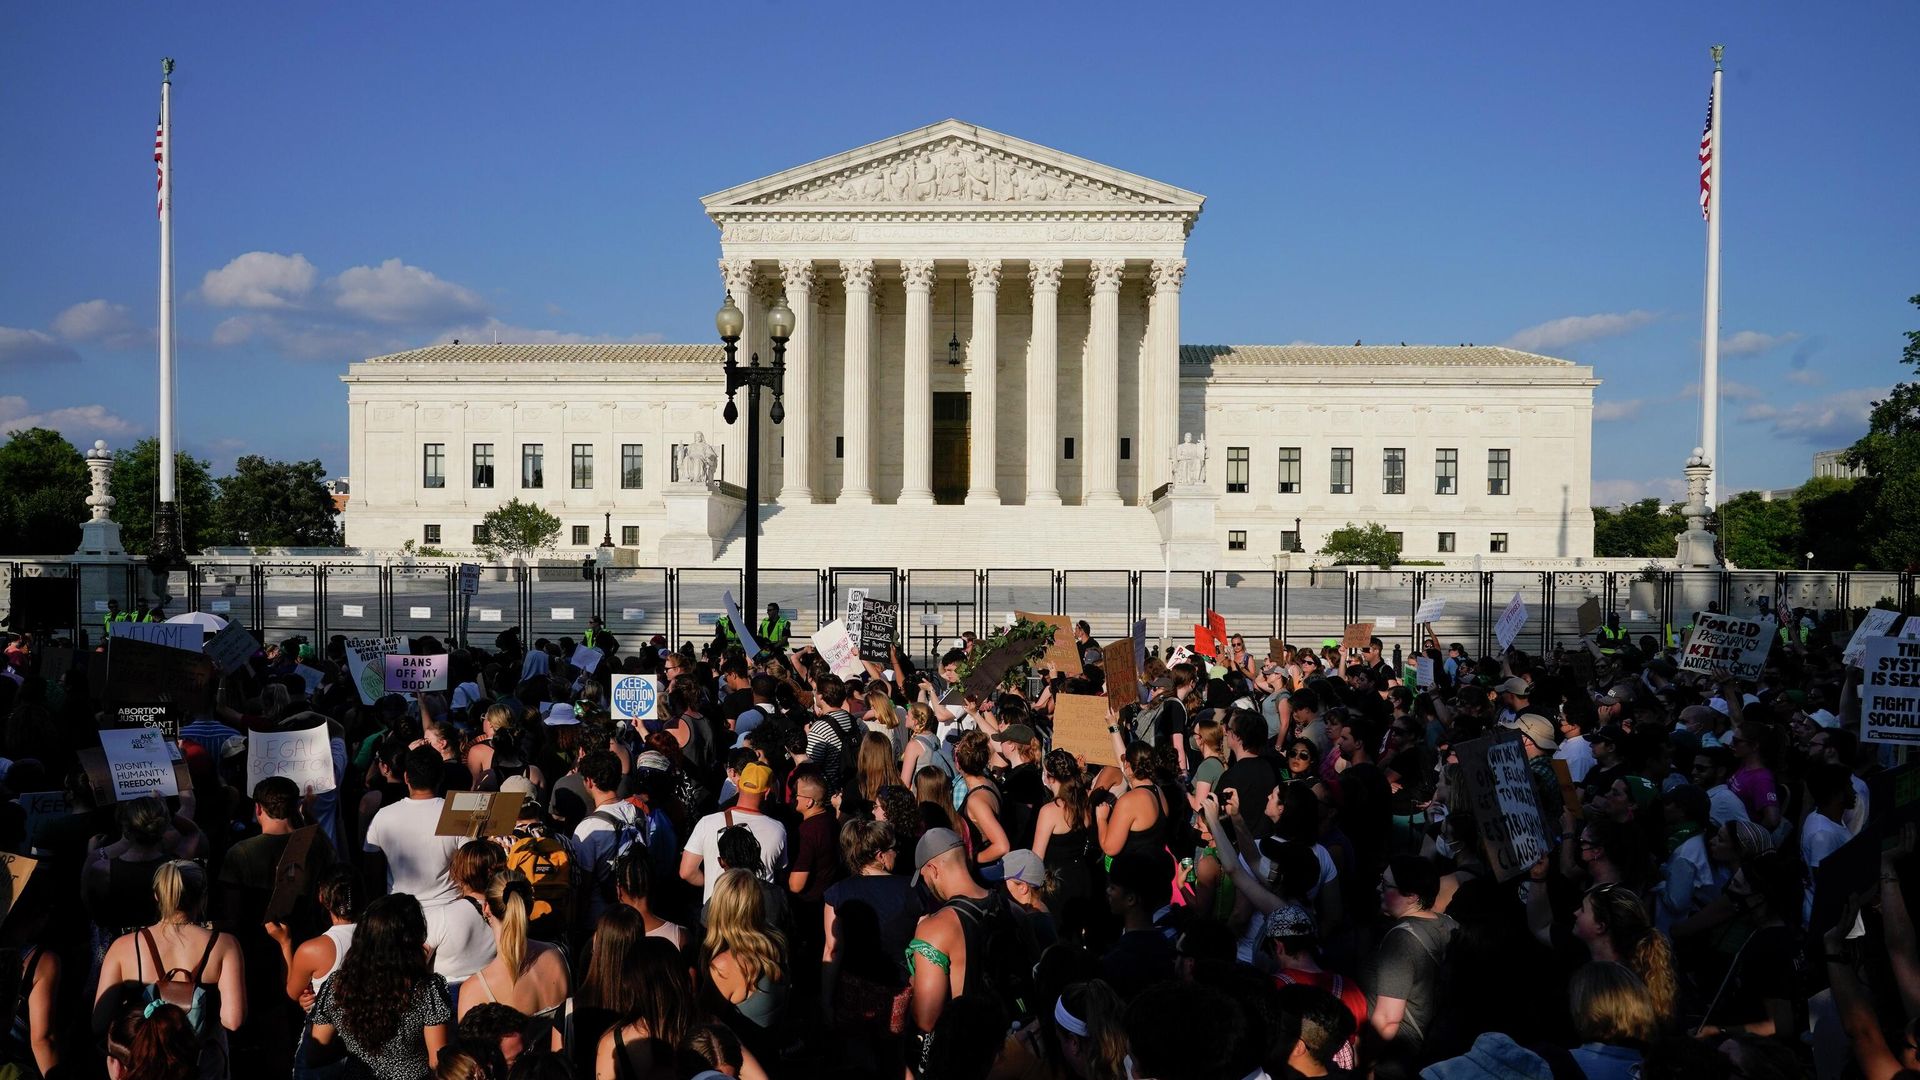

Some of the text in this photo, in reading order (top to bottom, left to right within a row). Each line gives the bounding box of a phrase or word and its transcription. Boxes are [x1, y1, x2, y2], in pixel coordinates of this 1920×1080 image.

[874, 601, 897, 616] POWER
[871, 613, 893, 625] PEOPLE
[871, 624, 886, 632] MUCH
[1699, 615, 1761, 637] FORCED
[346, 636, 402, 649] REASONS WHY
[1697, 629, 1760, 651] PREGNANCY
[355, 643, 398, 655] WOMEN HAVE
[871, 650, 888, 659] POWER
[1688, 643, 1736, 661] KILLS
[1898, 643, 1920, 657] TH
[402, 657, 432, 667] BANS
[1683, 656, 1720, 671] WOMEN
[1729, 660, 1763, 679] GIRLS!
[1878, 657, 1920, 672] SYST
[395, 668, 438, 678] OFF MY
[1871, 672, 1886, 685] IS
[402, 680, 432, 690] BODY
[622, 678, 648, 689] KEEP
[615, 688, 653, 701] ABORTION
[619, 700, 651, 713] LEGAL
[1873, 696, 1915, 712] FIGHT
[118, 706, 166, 715] ABORTION
[119, 714, 155, 722] JUSTICE
[144, 720, 173, 729] CAN'T
[160, 728, 176, 736] AIT.
[256, 737, 320, 760] LEGAL
[115, 760, 156, 772] DIGNITY.
[117, 768, 168, 780] HUMANITY.
[119, 778, 164, 789] FREEDOM.
